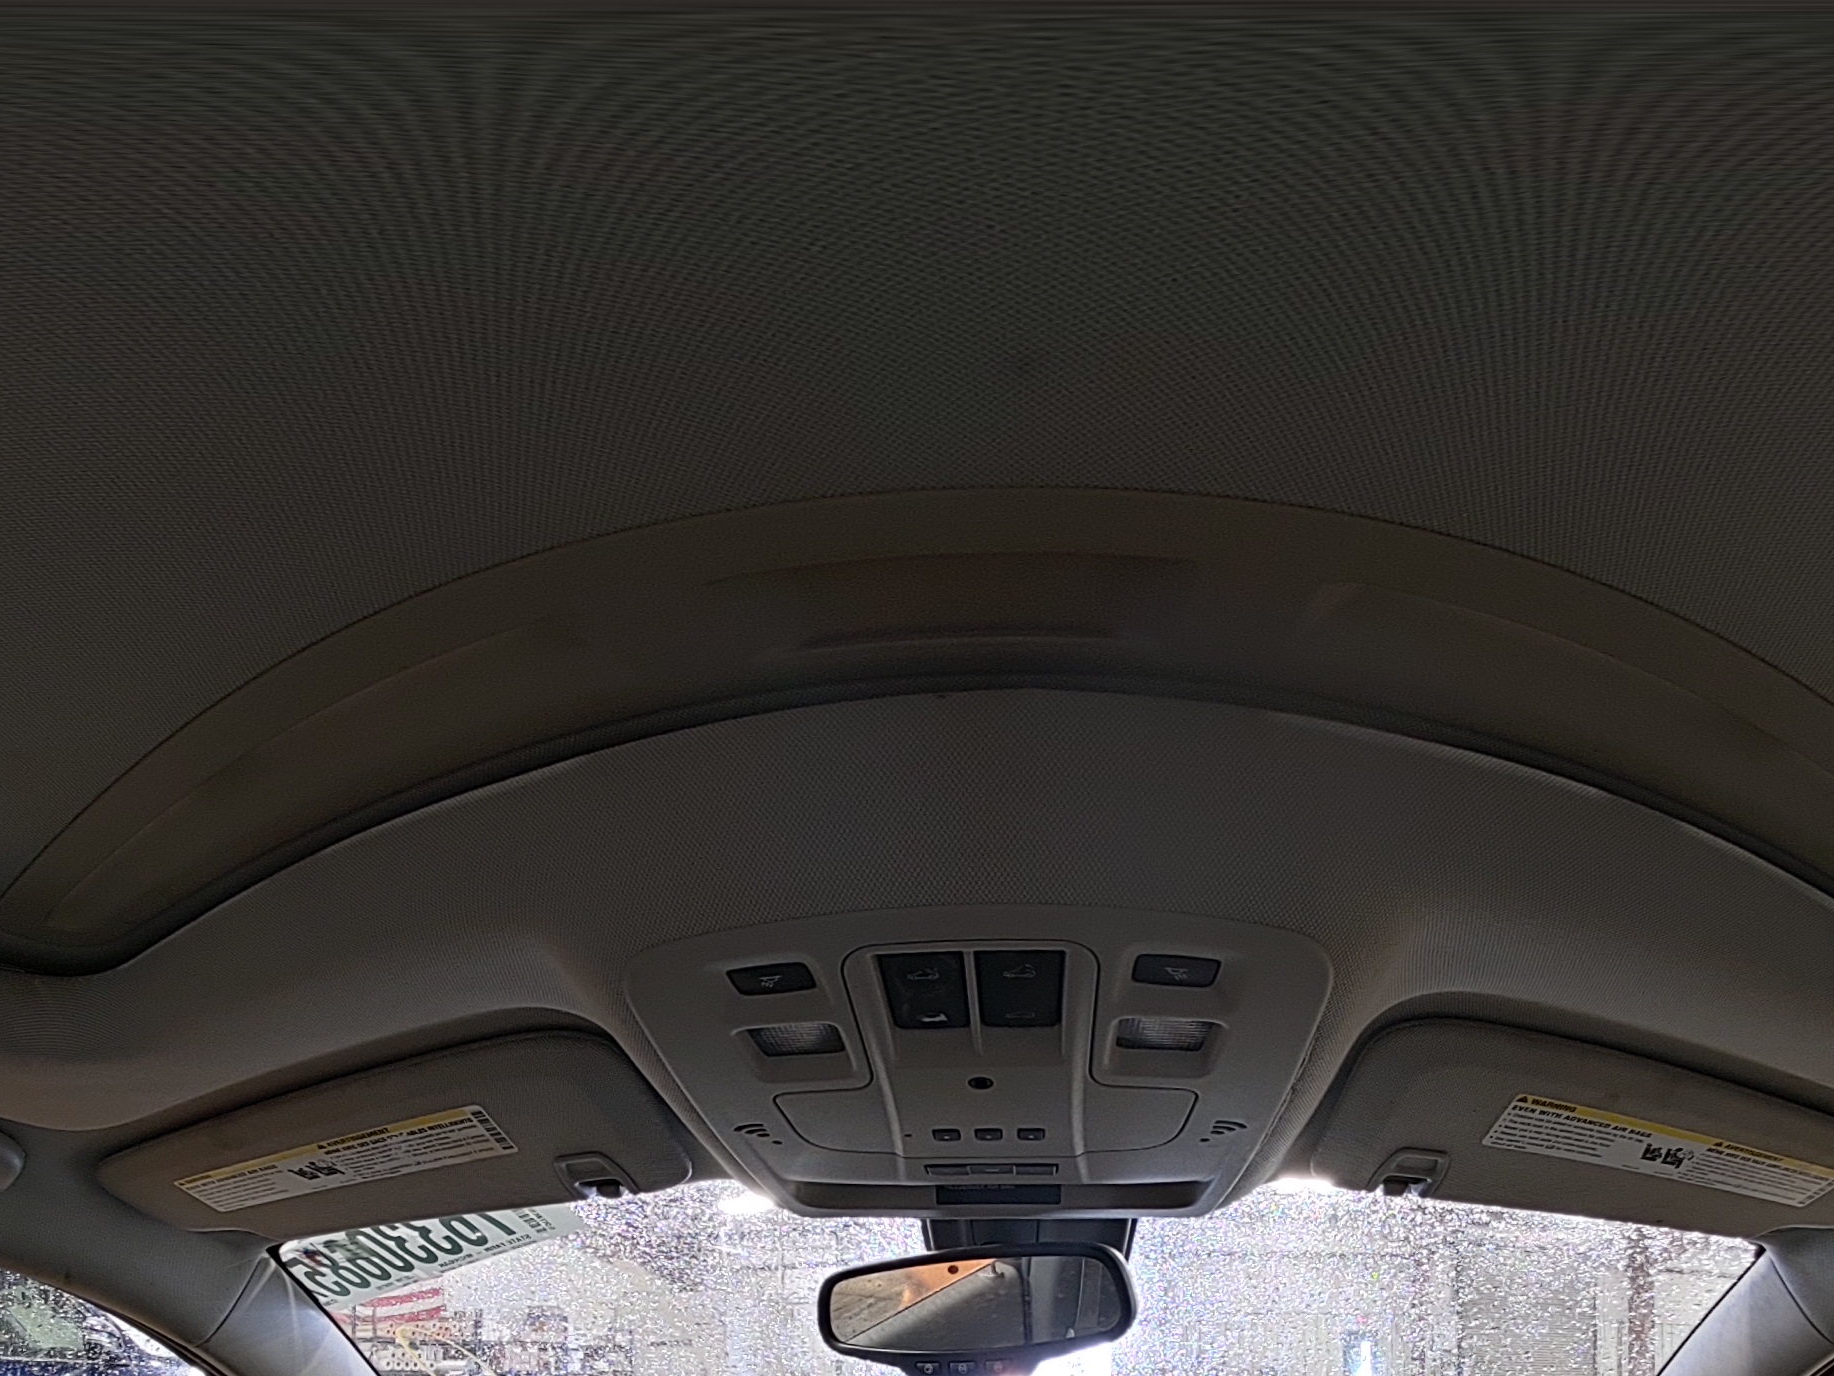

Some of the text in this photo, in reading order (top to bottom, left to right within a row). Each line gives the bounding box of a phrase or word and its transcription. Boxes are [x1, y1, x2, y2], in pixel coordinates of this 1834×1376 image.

[1531, 1097, 1577, 1113] WARNING
[1511, 1104, 1537, 1115] EVEN
[1538, 1109, 1563, 1119] WITH
[1563, 1114, 1610, 1129] ADVANCED
[1611, 1124, 1628, 1133] AIR
[1628, 1127, 1653, 1139] BAGS
